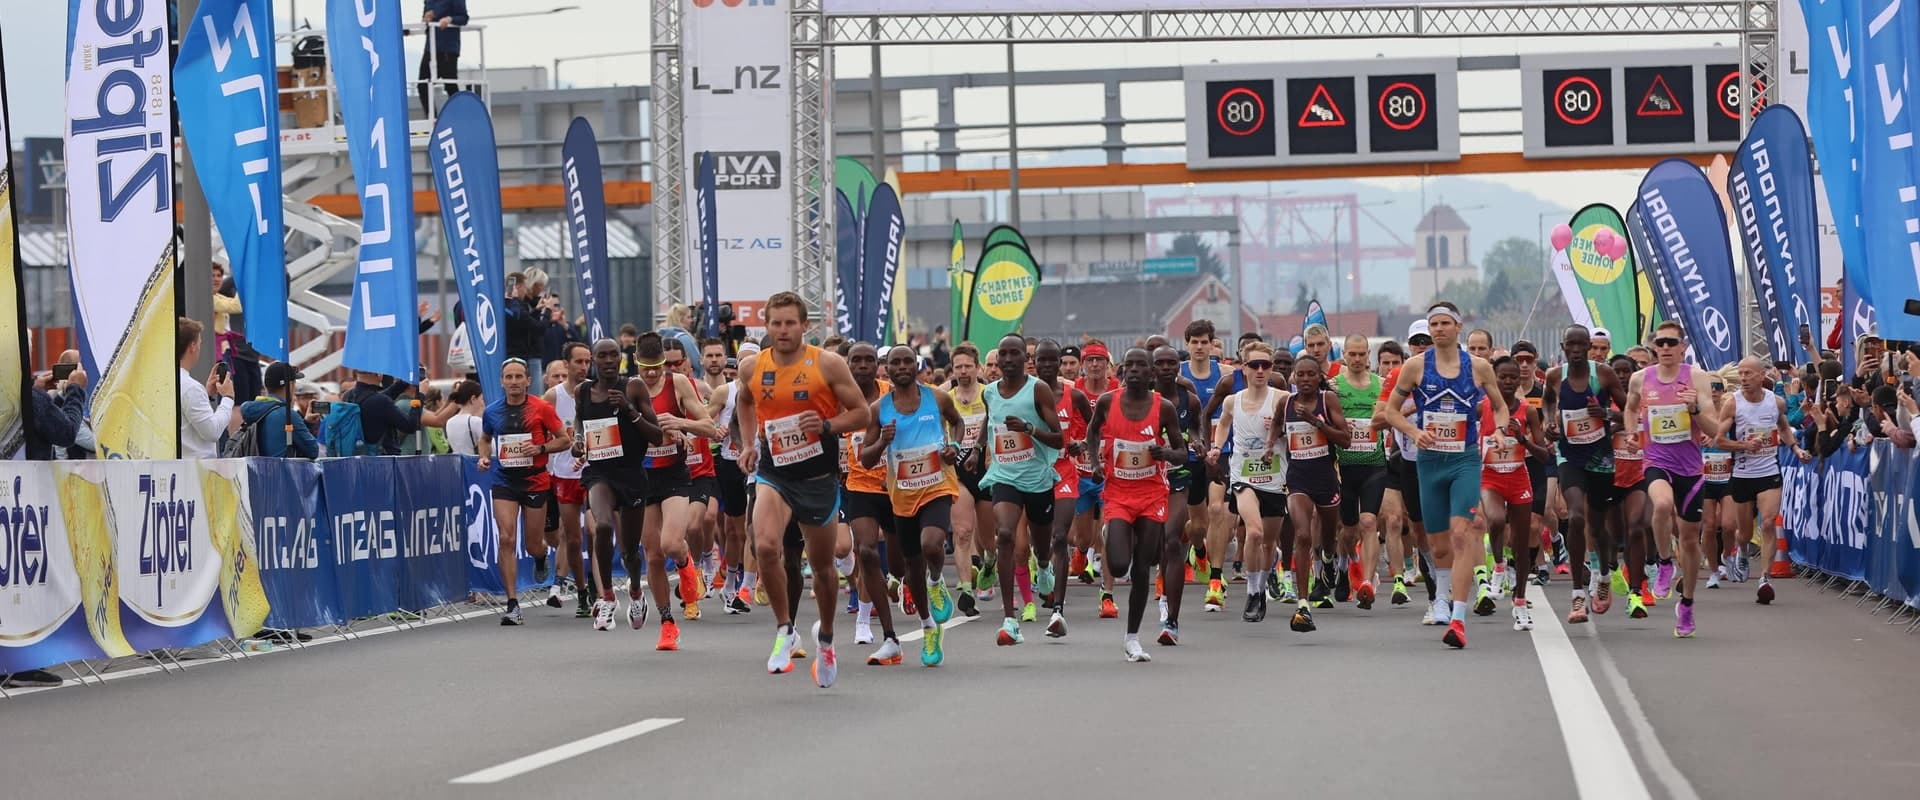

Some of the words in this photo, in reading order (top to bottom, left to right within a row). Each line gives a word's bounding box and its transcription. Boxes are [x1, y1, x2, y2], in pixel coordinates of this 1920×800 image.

[692, 65, 780, 94] L_nz
[1564, 89, 1591, 111] 80
[1727, 85, 1745, 106] 8
[1389, 95, 1416, 117] 80
[1227, 102, 1254, 123] 80
[715, 174, 776, 186] PORT
[750, 238, 782, 249] AG
[977, 274, 1033, 296] SCHARTNER
[990, 289, 1024, 305] BOMBE
[1577, 422, 1590, 432] 25
[1662, 420, 1677, 430] 2A
[595, 435, 601, 445] 7
[777, 432, 808, 449] 1794
[1300, 436, 1313, 446] 18
[1350, 431, 1371, 440] 1834
[1003, 439, 1016, 449] 28
[776, 447, 819, 464] Oberbank
[999, 453, 1032, 463] Oberbank
[1292, 450, 1327, 459] Oberbank
[1132, 457, 1138, 465] 8
[910, 463, 923, 474] 27
[1116, 470, 1154, 479] Oberbank
[901, 477, 939, 488] Oberbank
[139, 473, 195, 607] Zipfer
